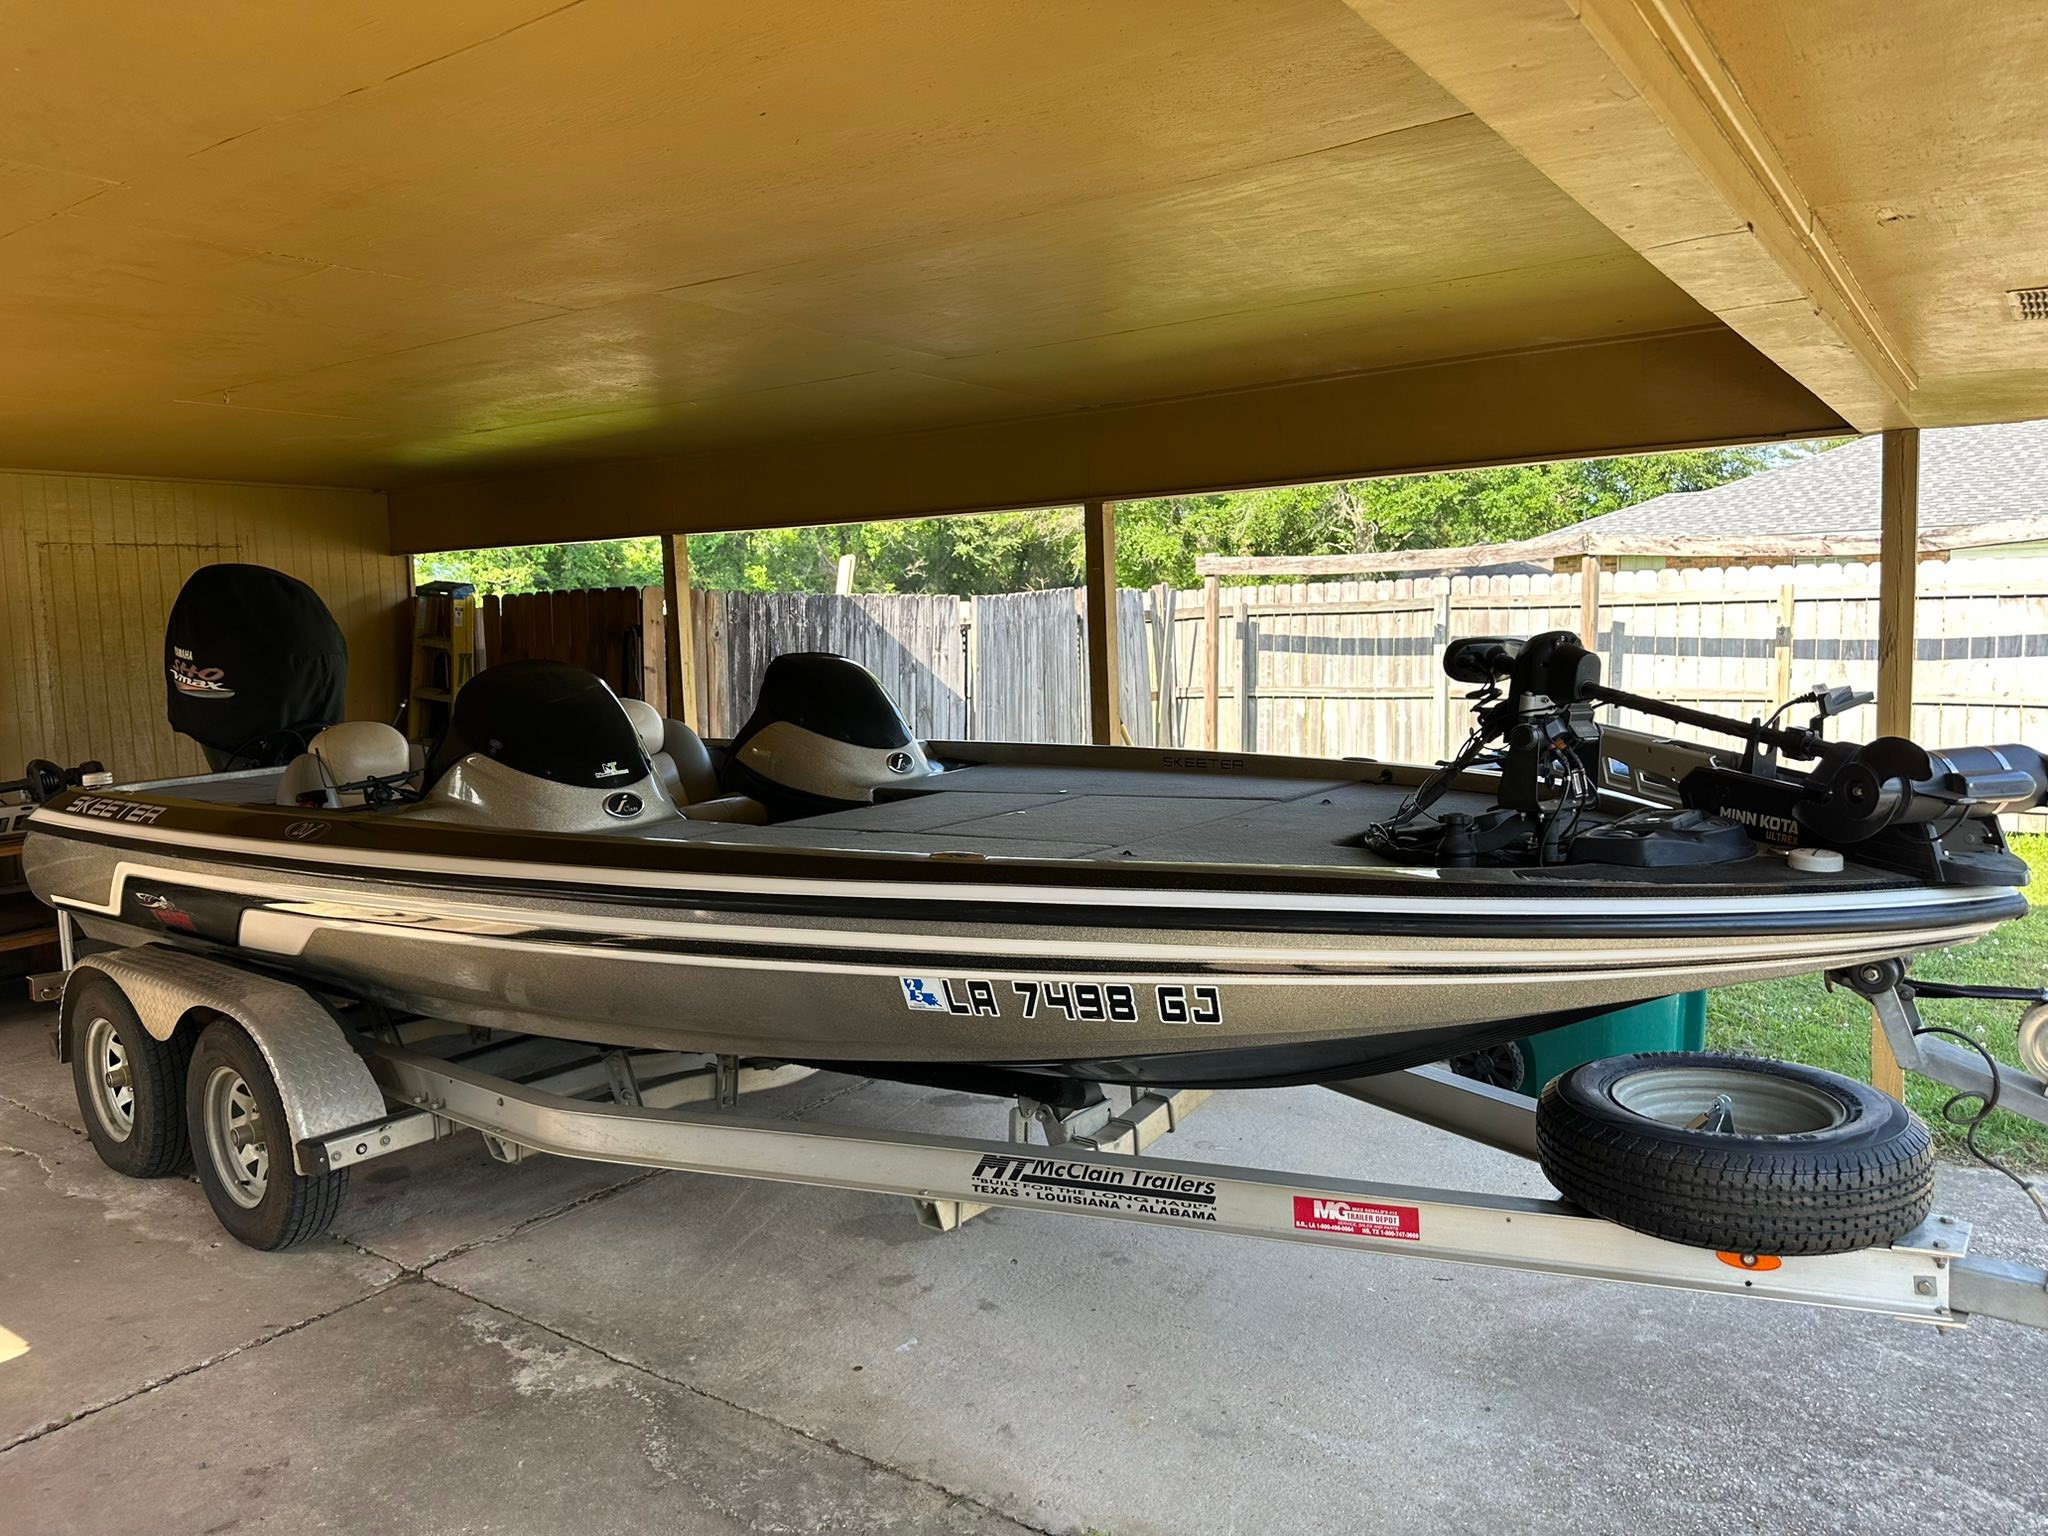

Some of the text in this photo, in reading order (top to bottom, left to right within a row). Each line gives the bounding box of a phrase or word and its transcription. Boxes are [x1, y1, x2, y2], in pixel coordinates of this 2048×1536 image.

[172, 659, 224, 680] SHO
[1163, 756, 1244, 770] SKEETER
[65, 795, 168, 824] SKEETER
[1720, 806, 1799, 834] MINN KOTA
[1766, 830, 1798, 845] ULTREX
[940, 978, 1224, 1024] LA 7498 GJ
[1032, 1159, 1123, 1185] McClain
[1131, 1169, 1216, 1195] Trailers
[972, 1184, 1217, 1221] TEXAS LOUISIANA ALABAMA
[1023, 1183, 1053, 1192] FOR
[1057, 1187, 1086, 1196] THE
[1092, 1191, 1149, 1203] LONG
[1346, 1212, 1398, 1225] TRAILER DEPOT
